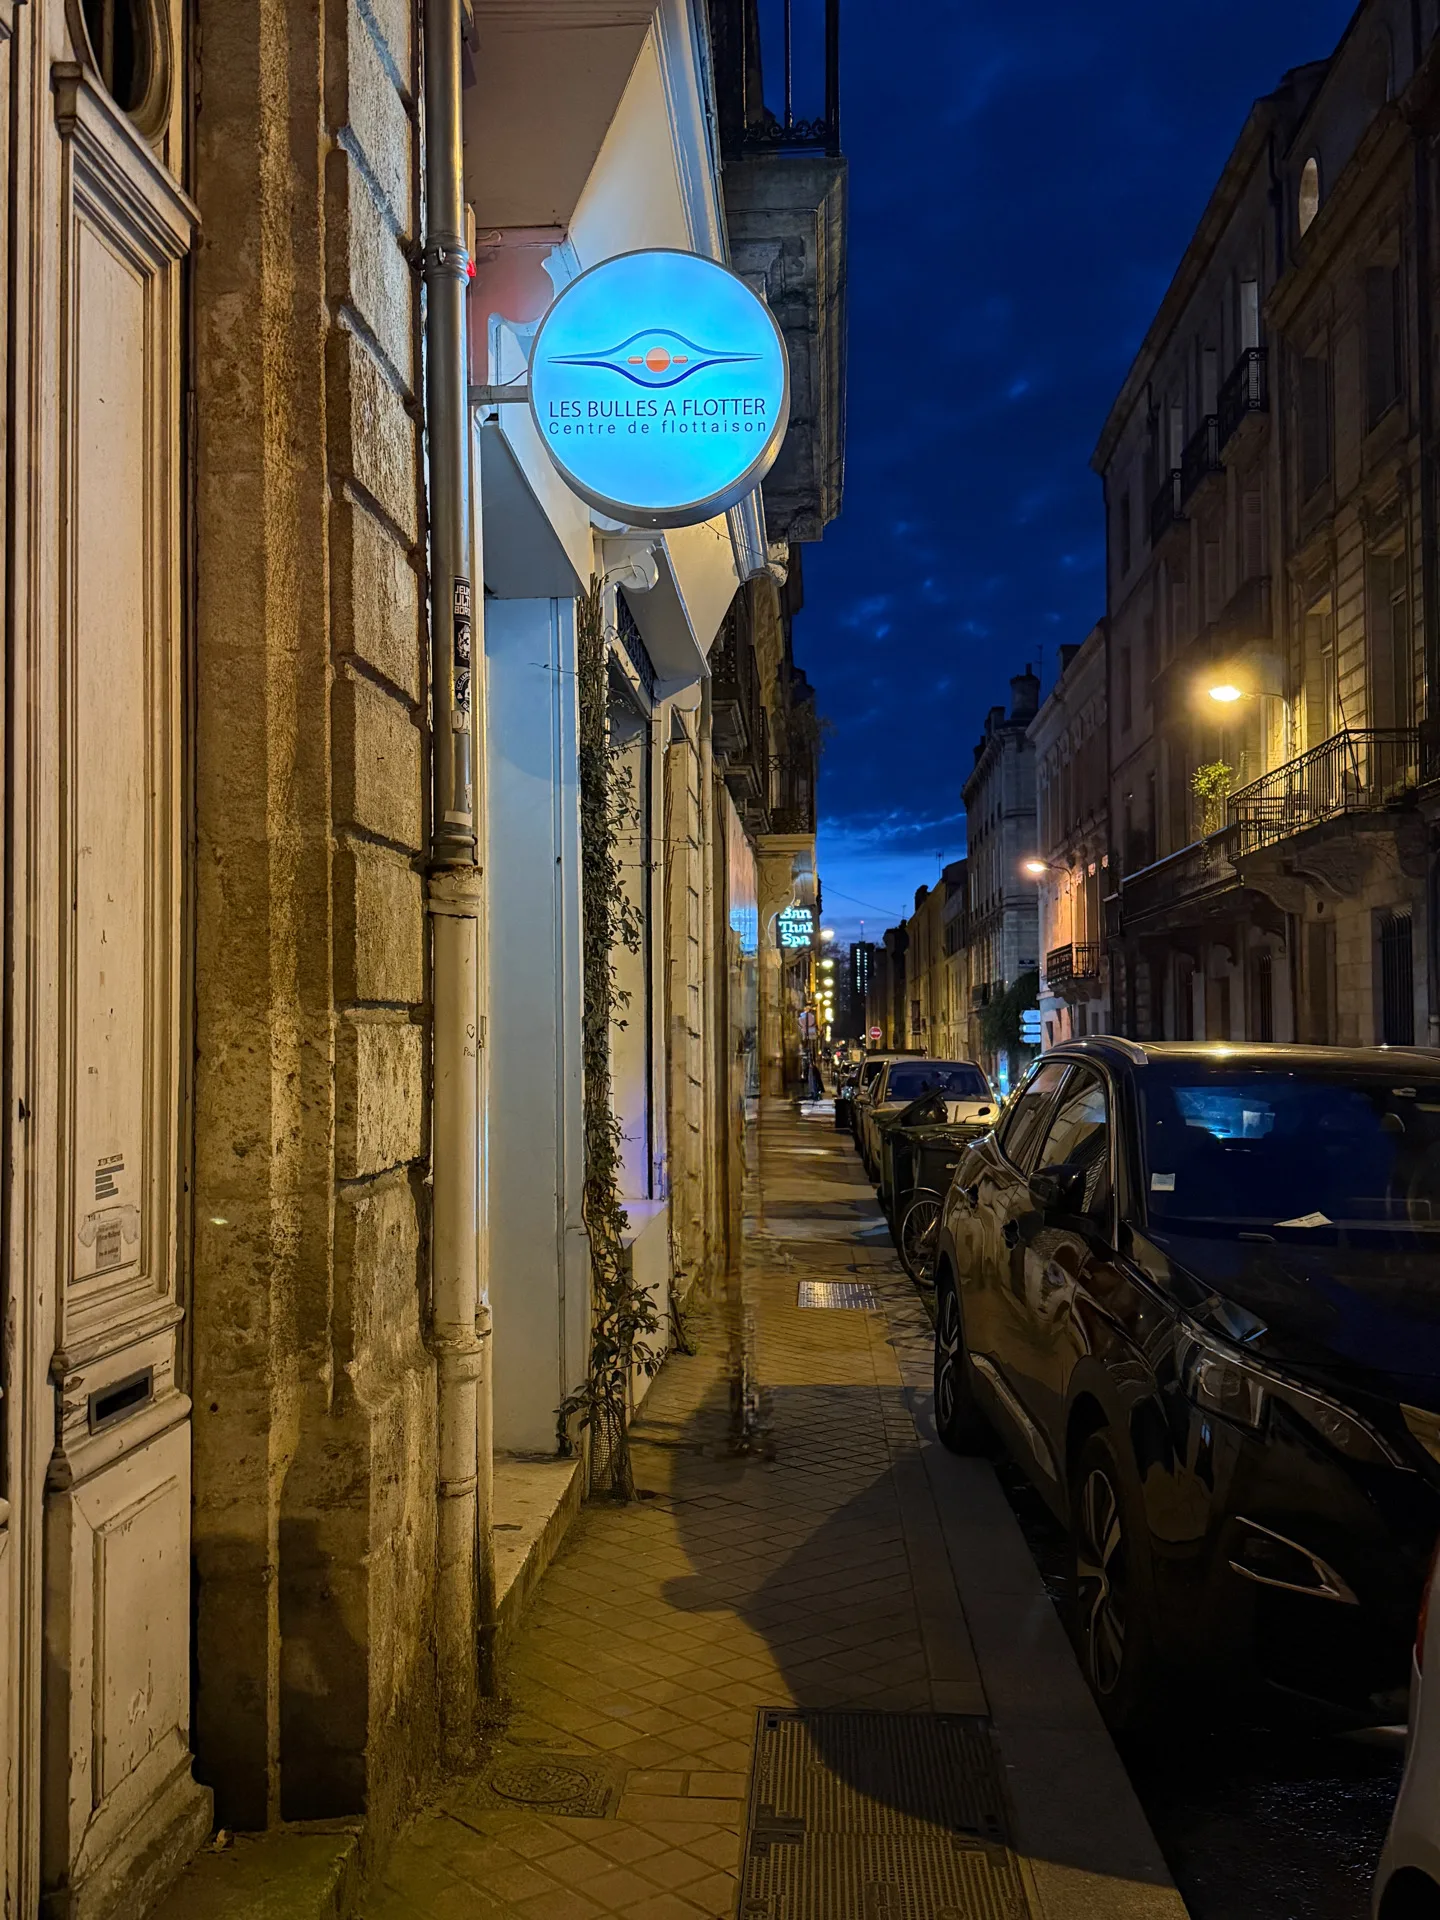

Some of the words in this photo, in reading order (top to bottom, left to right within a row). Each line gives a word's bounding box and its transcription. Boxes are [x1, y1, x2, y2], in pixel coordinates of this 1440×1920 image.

[549, 400, 582, 418] LES
[587, 399, 658, 417] BULLES
[663, 399, 677, 416] A
[682, 398, 766, 416] FLOTTER
[549, 422, 617, 435] Centre
[628, 421, 650, 434] de
[661, 420, 767, 434] flottaison
[781, 933, 811, 947] Spa
